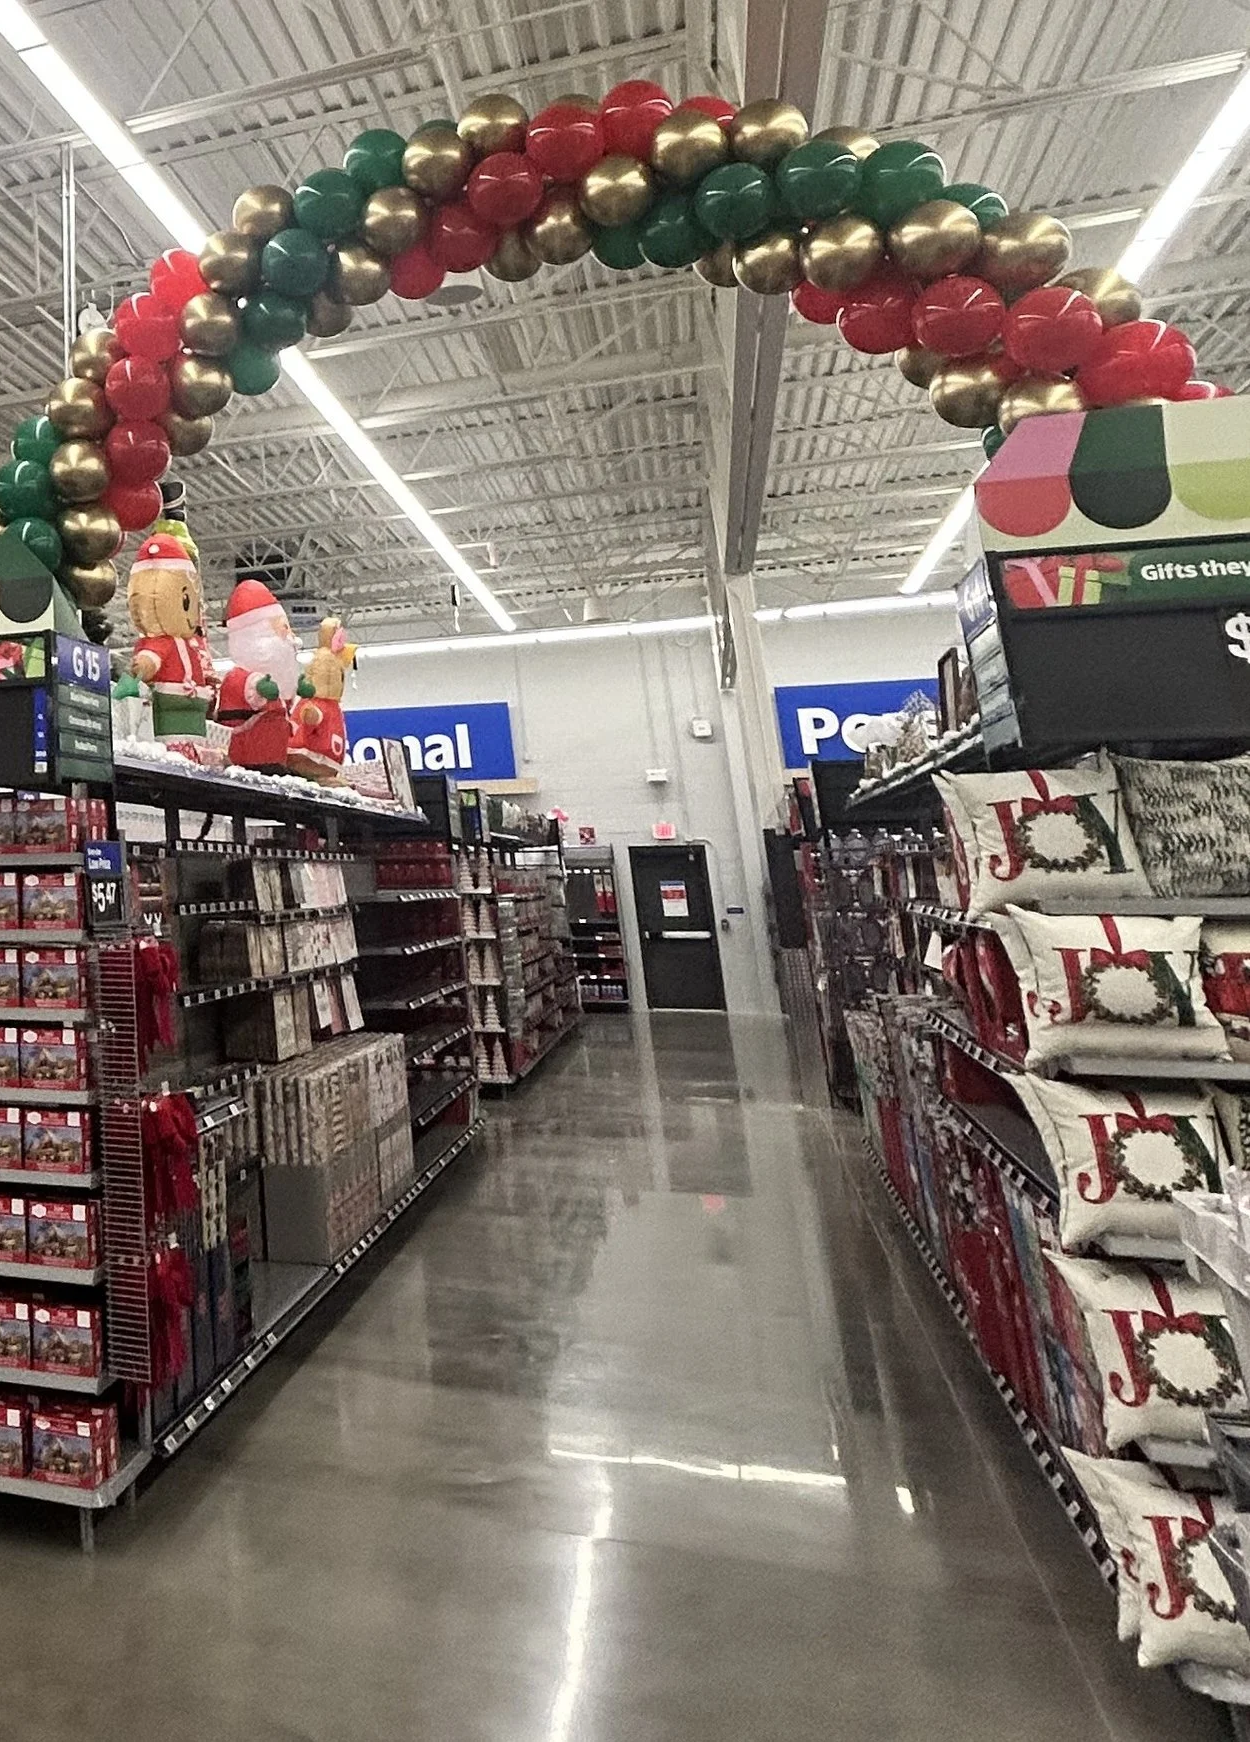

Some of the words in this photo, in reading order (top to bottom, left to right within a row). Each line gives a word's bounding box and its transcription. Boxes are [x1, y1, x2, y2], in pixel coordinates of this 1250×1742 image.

[1141, 563, 1198, 580] Gifts
[72, 646, 84, 678] G
[85, 649, 101, 682] 15
